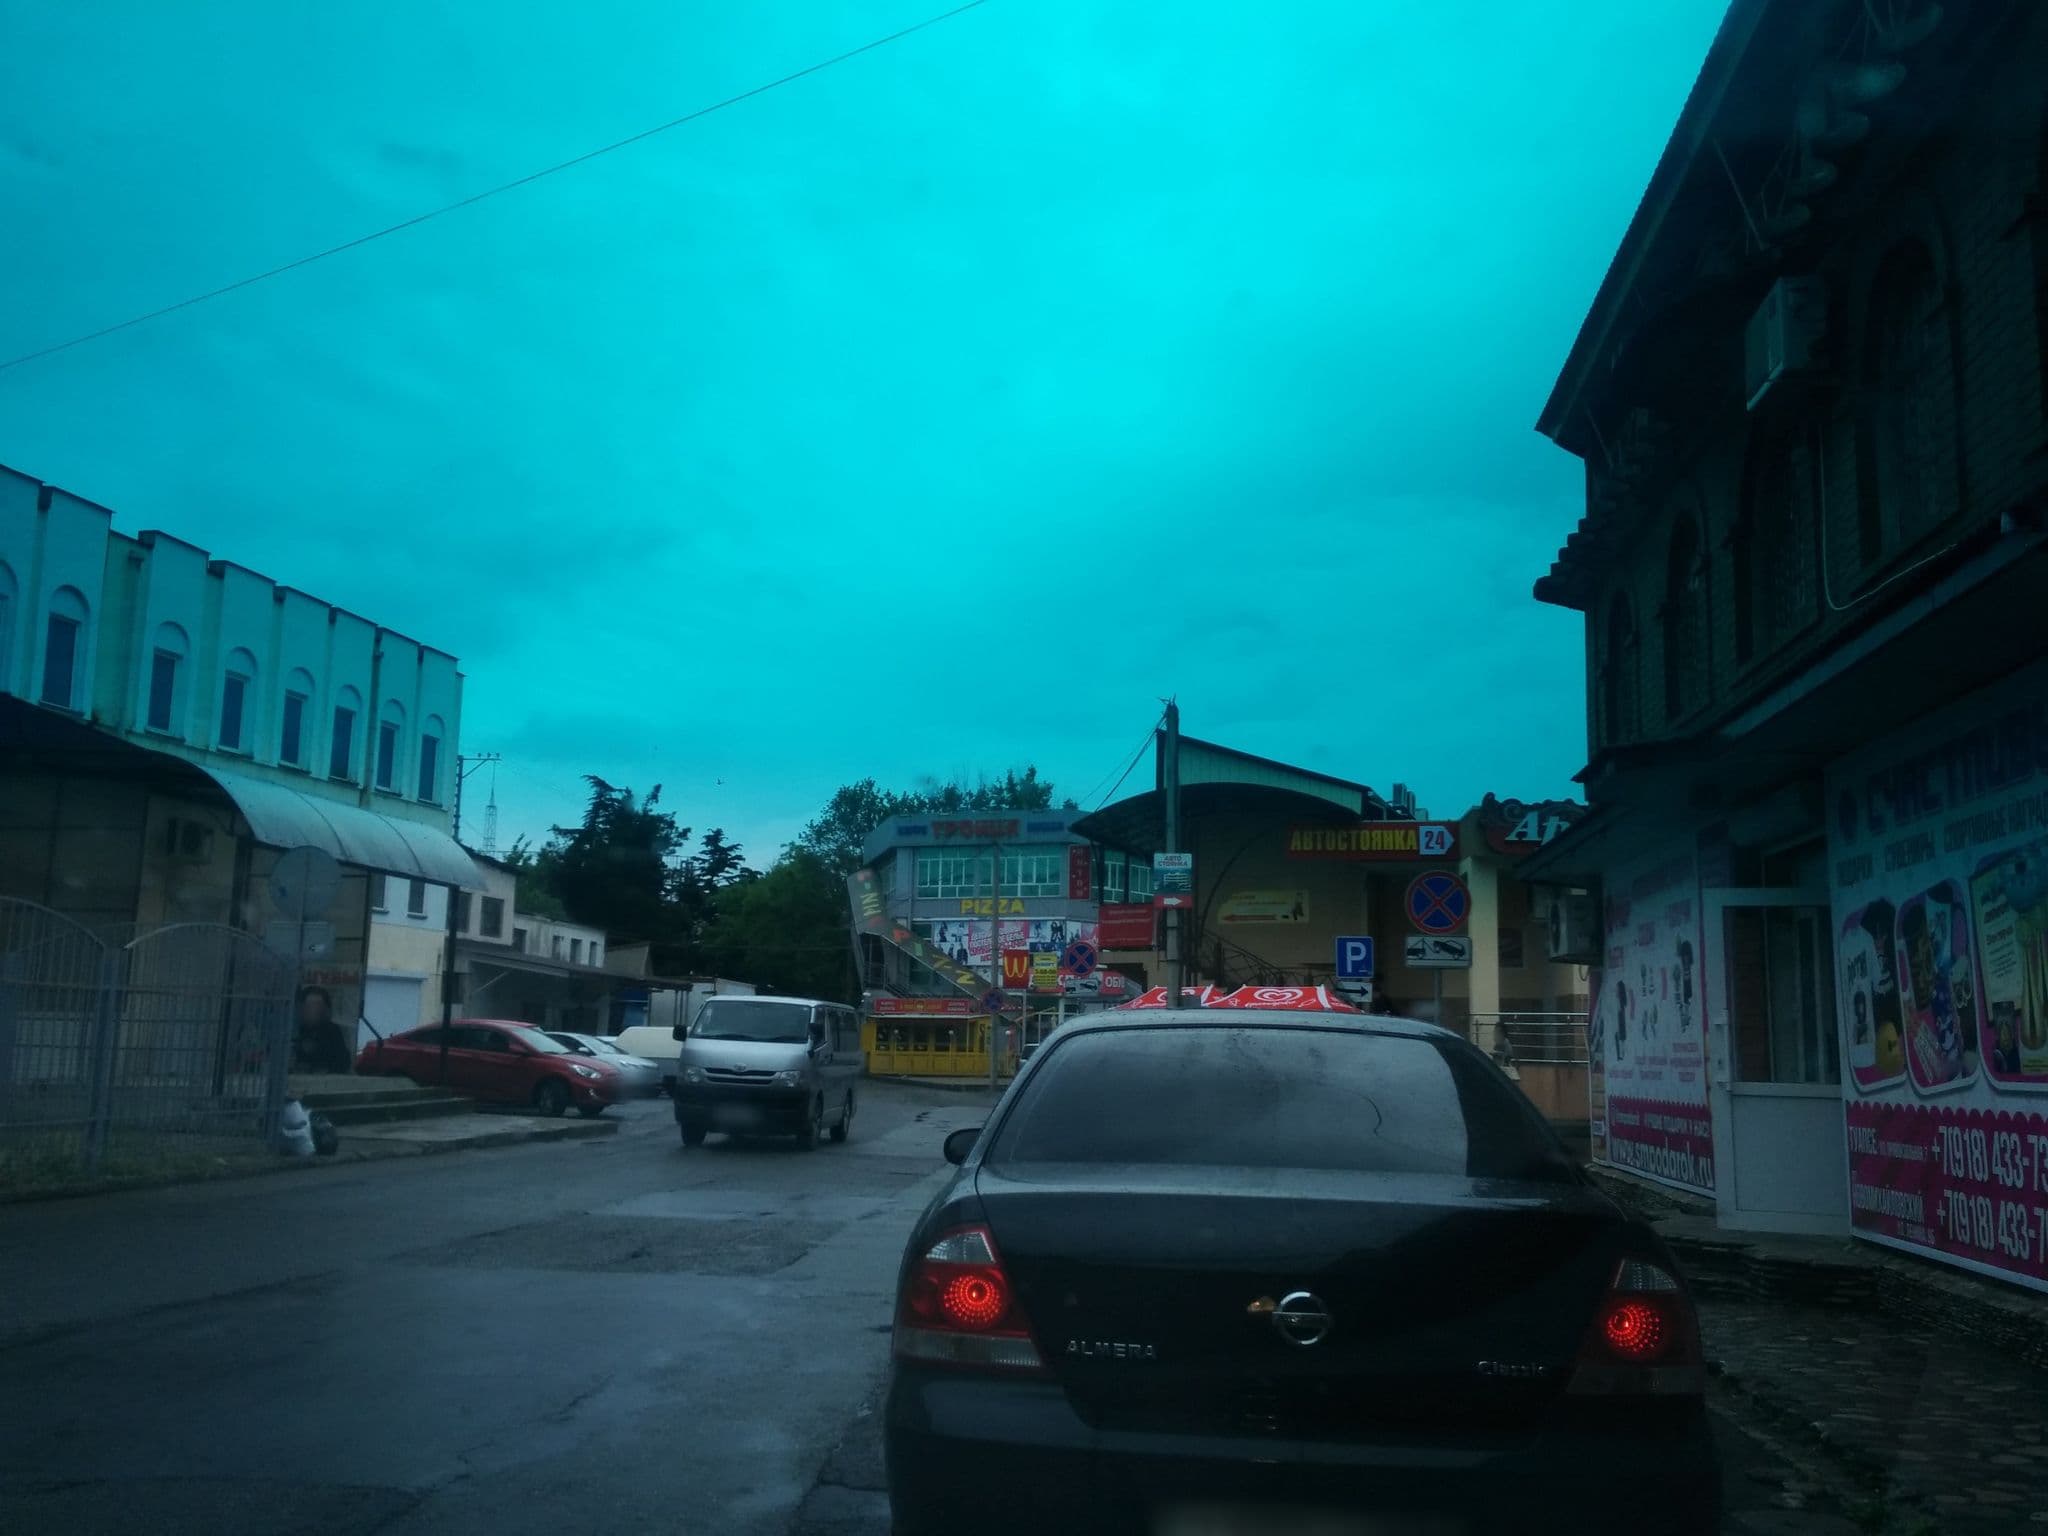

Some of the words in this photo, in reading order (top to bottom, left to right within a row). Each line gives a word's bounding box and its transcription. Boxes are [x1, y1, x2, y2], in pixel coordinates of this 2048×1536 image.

[1290, 829, 1418, 852] АВТОСТОЯНКА
[1424, 830, 1445, 850] 24
[1505, 811, 1570, 847] Ар
[960, 899, 1024, 915] PIZZA
[1345, 941, 1367, 974] P
[1998, 1200, 2048, 1264] 433-7
[1066, 1340, 1157, 1360] ALMERA
